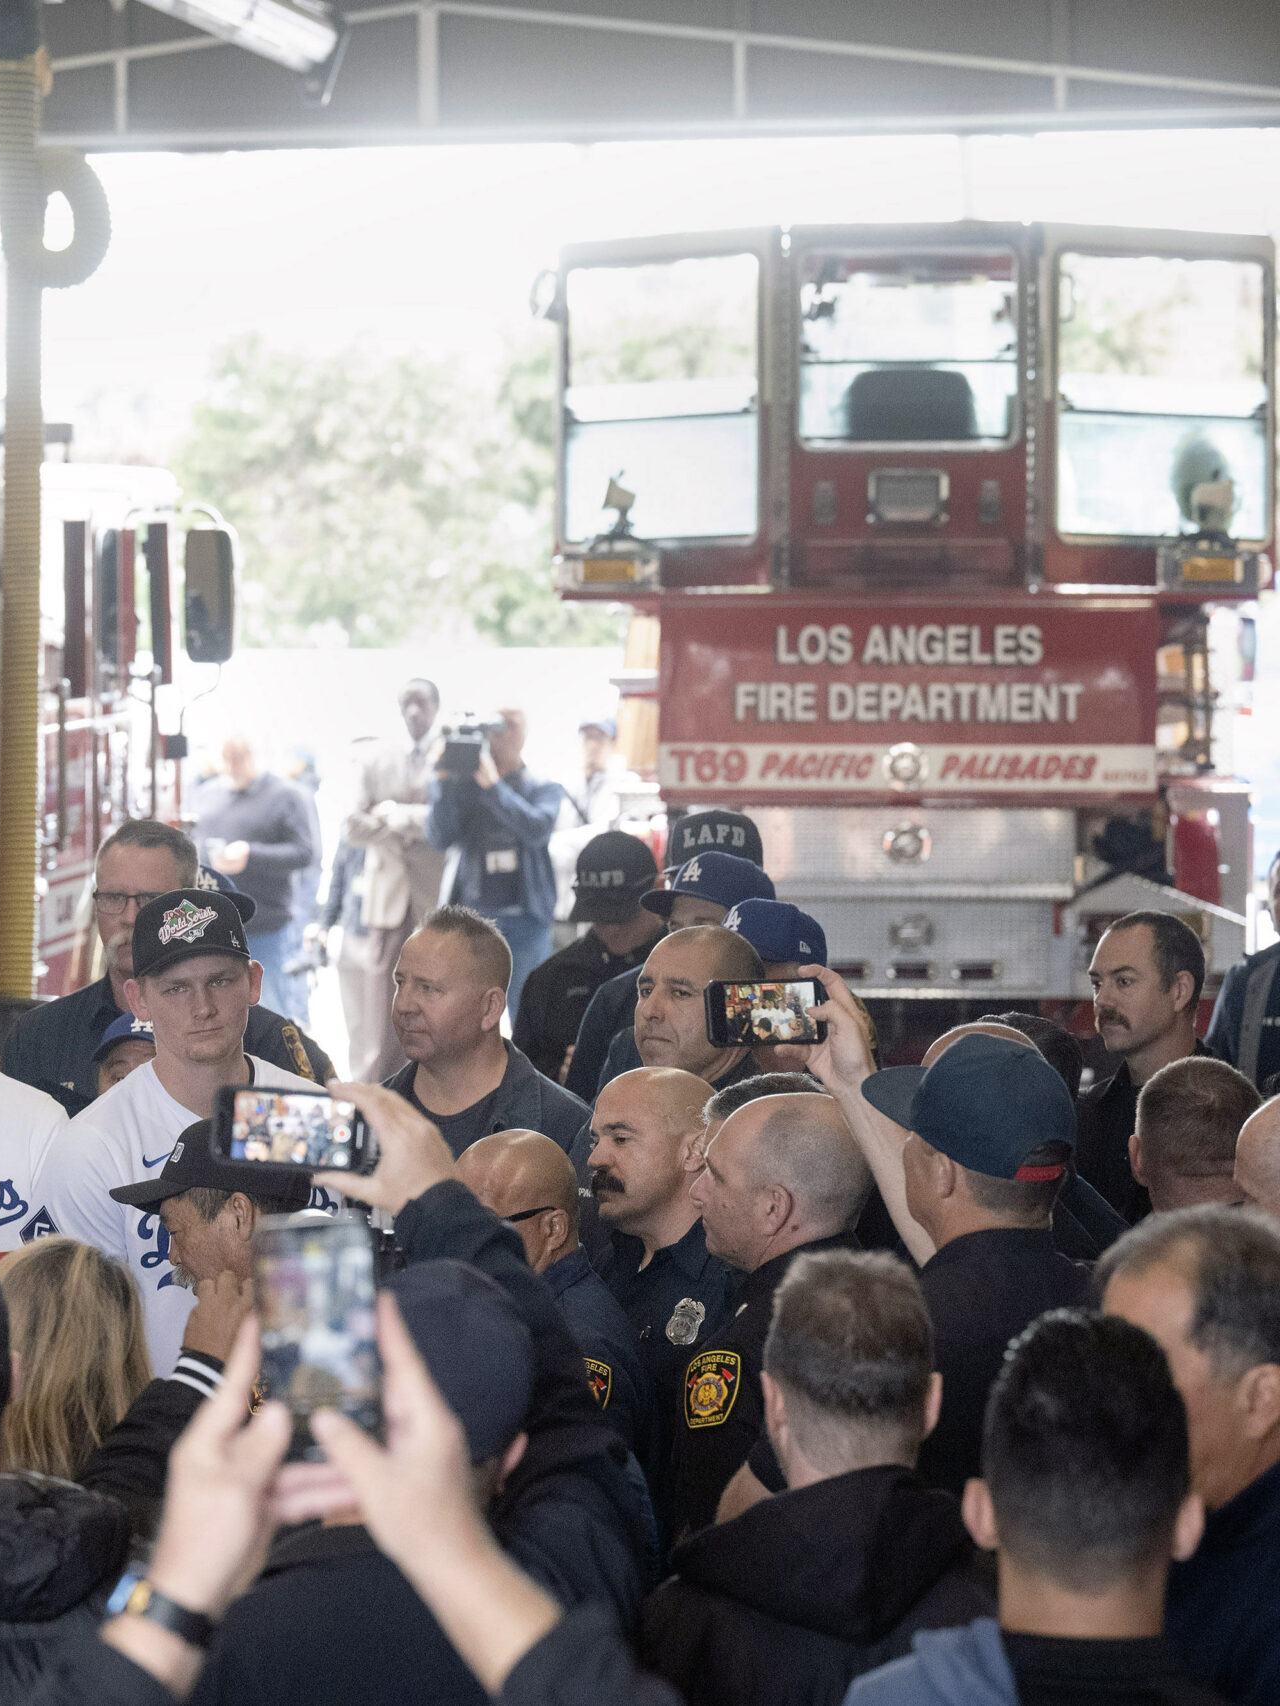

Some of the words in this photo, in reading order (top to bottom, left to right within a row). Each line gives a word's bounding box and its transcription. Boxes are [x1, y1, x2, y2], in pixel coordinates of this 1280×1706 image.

[776, 624, 853, 665] LOS
[862, 624, 1044, 665] ANGELES
[734, 682, 817, 722] FIRE
[827, 682, 1085, 722] DEPARTMENT
[670, 750, 748, 782] T69
[759, 753, 875, 780] PACIFIC
[939, 754, 1097, 780] PALISADES
[682, 823, 746, 848] LAFD
[158, 916, 188, 943] World
[585, 1361, 609, 1376] GELES
[701, 1354, 737, 1366] ANGELES
[701, 1363, 718, 1374] FIRE
[690, 1413, 724, 1425] DEPARTMENT
